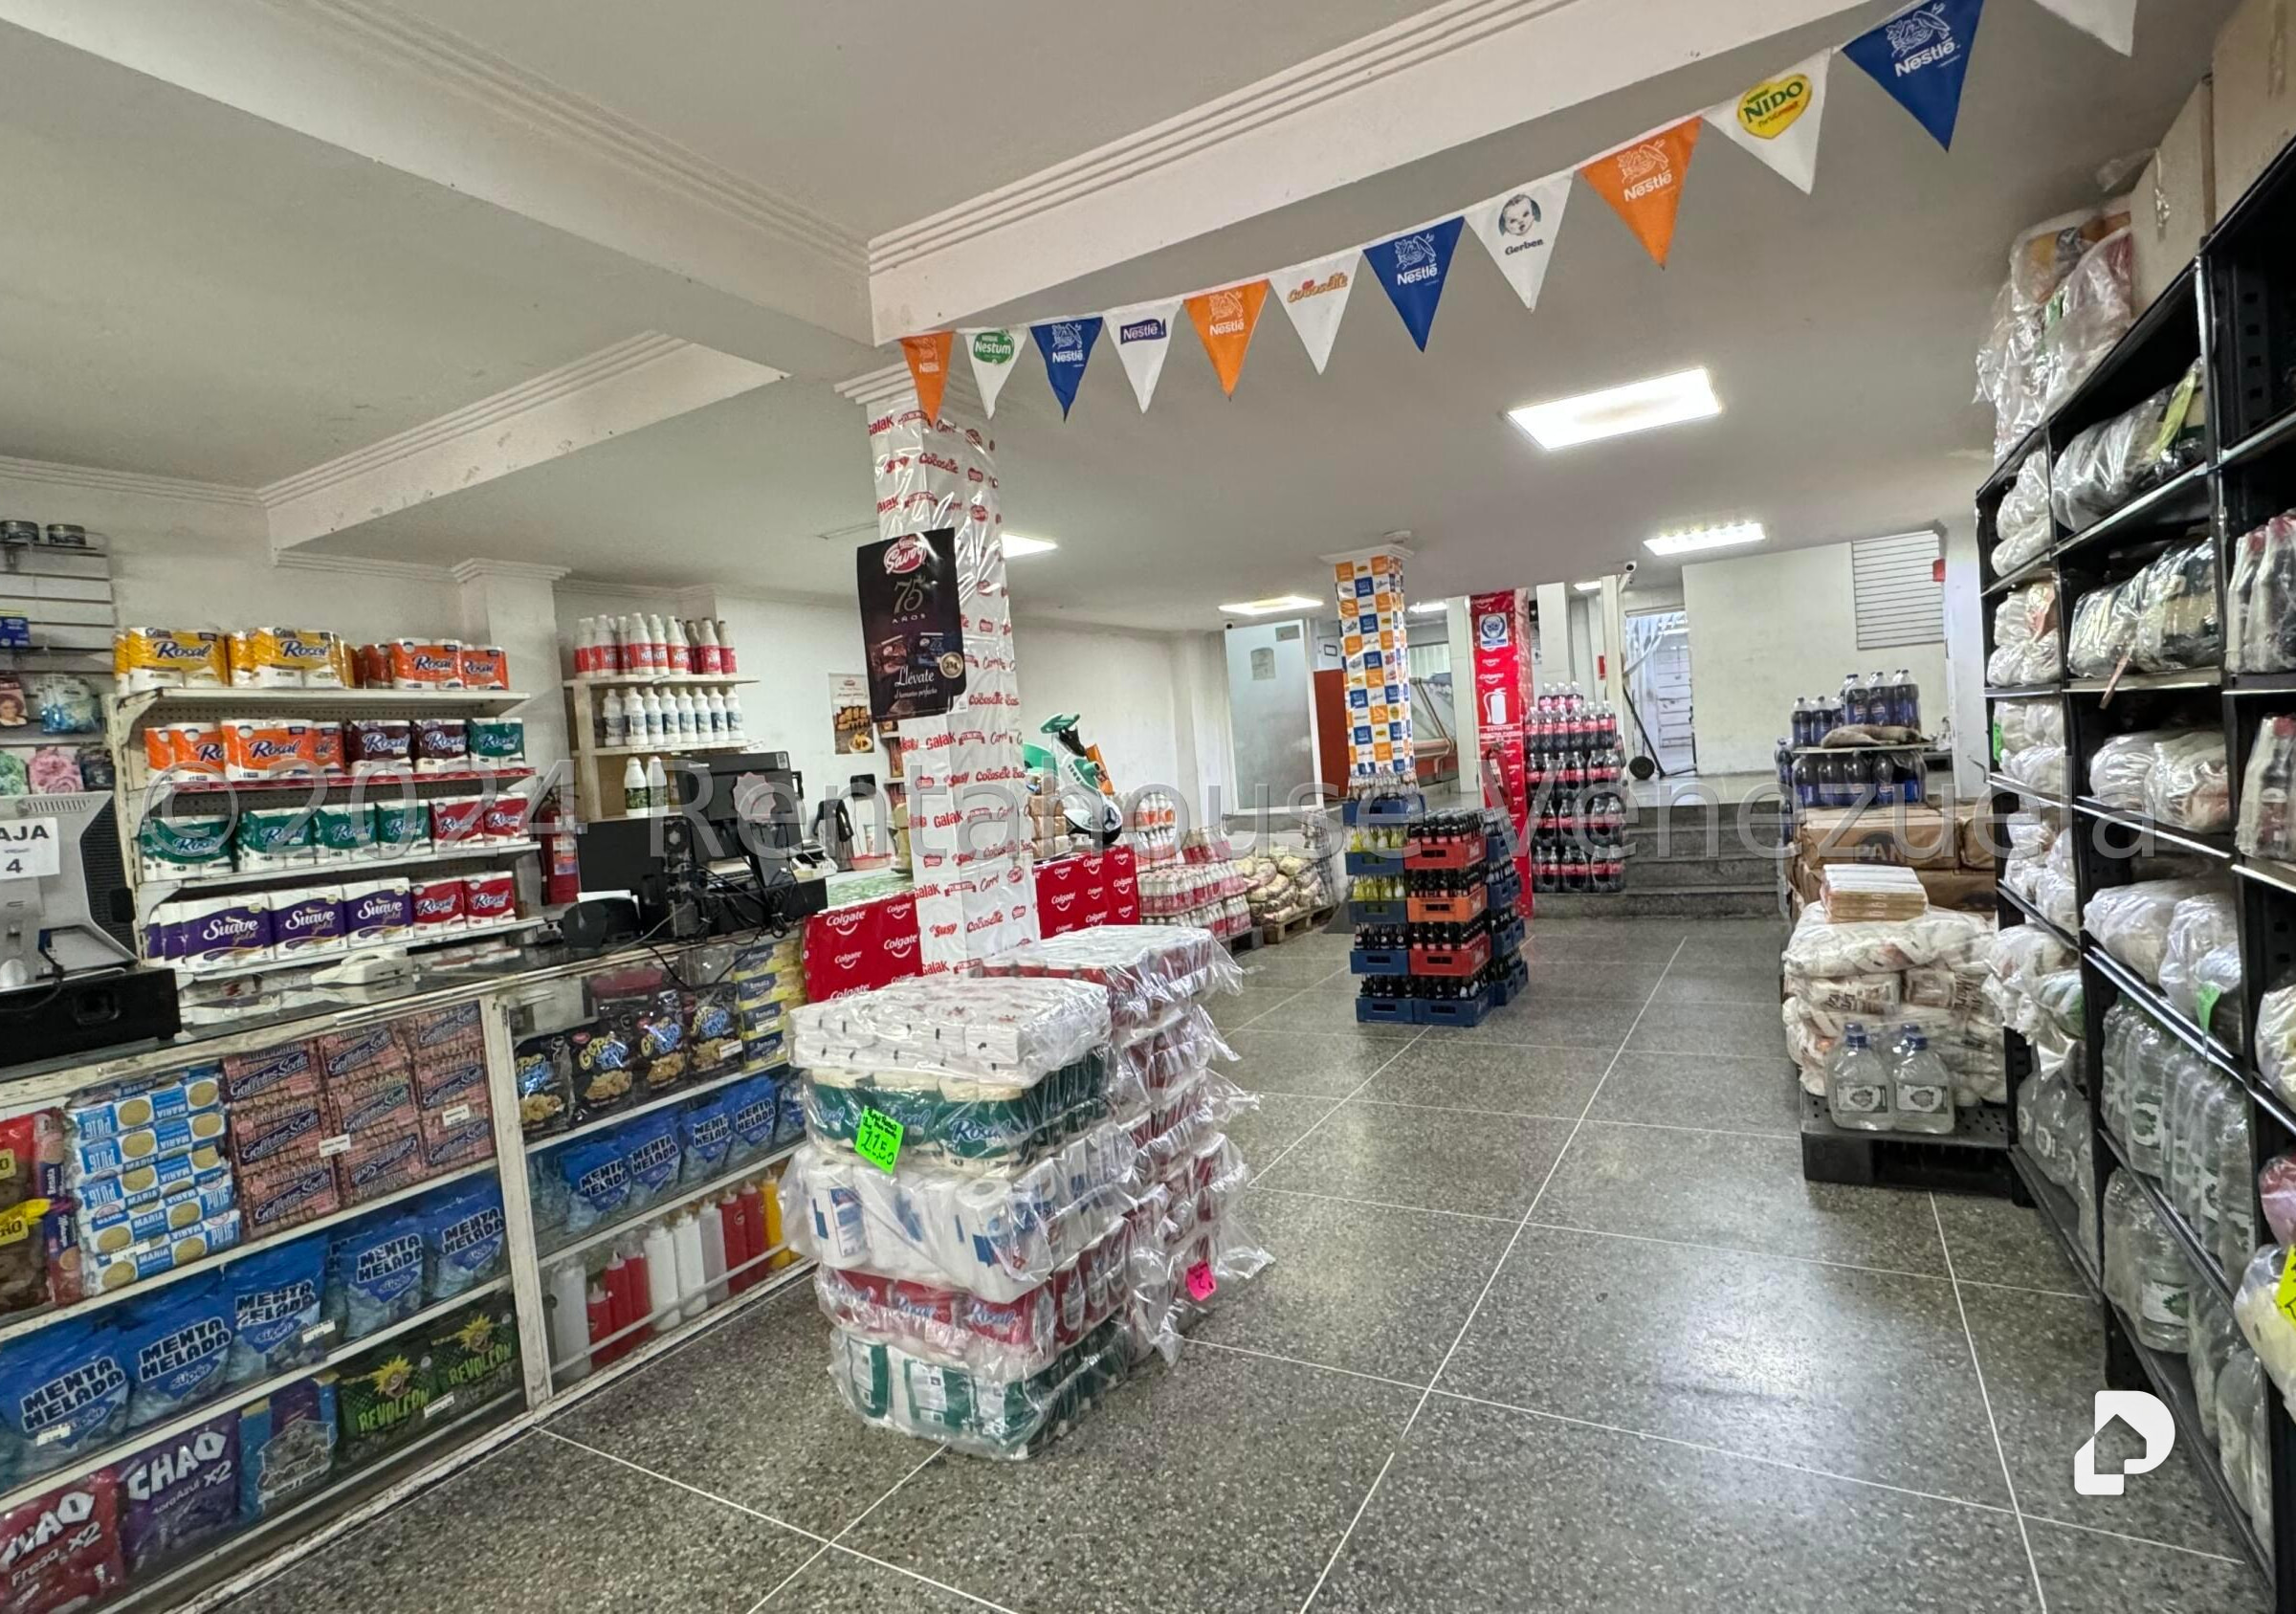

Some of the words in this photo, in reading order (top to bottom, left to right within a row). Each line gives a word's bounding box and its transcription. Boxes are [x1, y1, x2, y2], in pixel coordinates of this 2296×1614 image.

[1894, 36, 1957, 77] Nestlé
[1743, 80, 1803, 123] NIDO
[1623, 169, 1673, 202] Nestlé
[1397, 263, 1438, 286] Nestlé
[1123, 322, 1159, 340] Nestlé
[1209, 320, 1245, 336] Nestlé
[975, 341, 1011, 354] Nestum
[1052, 349, 1083, 364] Nestlé
[886, 543, 925, 575] Savoy
[894, 576, 925, 614] 75
[153, 640, 211, 659] Rosal
[280, 639, 330, 657] Rosal
[412, 655, 454, 671] Rosal
[894, 666, 935, 687] Llévate
[249, 740, 301, 759] Rosal
[362, 732, 409, 754] Rosal
[6, 858, 23, 874] 4
[358, 897, 403, 919] Suave
[1051, 892, 1076, 905] Colgate
[203, 917, 259, 940] Suave
[285, 907, 336, 930] Suave
[827, 910, 867, 926] Colgate
[883, 934, 918, 950] Colgate
[834, 951, 863, 964] Colgate
[231, 1070, 277, 1098] Galletas
[279, 1053, 308, 1077] Soda
[736, 1099, 773, 1122] MENTA
[736, 1108, 775, 1133] HELADA
[243, 1129, 290, 1161] Galletas
[290, 1112, 319, 1136] Soda
[631, 1134, 673, 1161] MENTA
[694, 1124, 729, 1148] HELAD
[631, 1143, 677, 1174] HELADA
[207, 1188, 230, 1210] PUIG
[255, 1192, 302, 1224] Galletas
[302, 1172, 330, 1198] Soda
[134, 1213, 165, 1228] MARIA
[443, 1207, 500, 1242] MENTA
[211, 1224, 234, 1245] PUIG
[442, 1217, 505, 1255] HELADA
[139, 1247, 170, 1264] MARIA
[359, 1234, 421, 1269] MENTA
[358, 1247, 425, 1283] HELADA
[237, 1281, 314, 1311] MENTA
[141, 1317, 224, 1364] MENTA
[140, 1329, 232, 1382] HELADA
[449, 1342, 513, 1385] REVOLCON
[21, 1357, 115, 1414] MENTA
[22, 1368, 126, 1432] HELADA
[358, 1388, 430, 1432] REVOLCON
[127, 1431, 227, 1501] CHAO
[203, 1460, 232, 1488] x2
[11, 1548, 59, 1586] Fresa
[68, 1521, 102, 1552] x2
